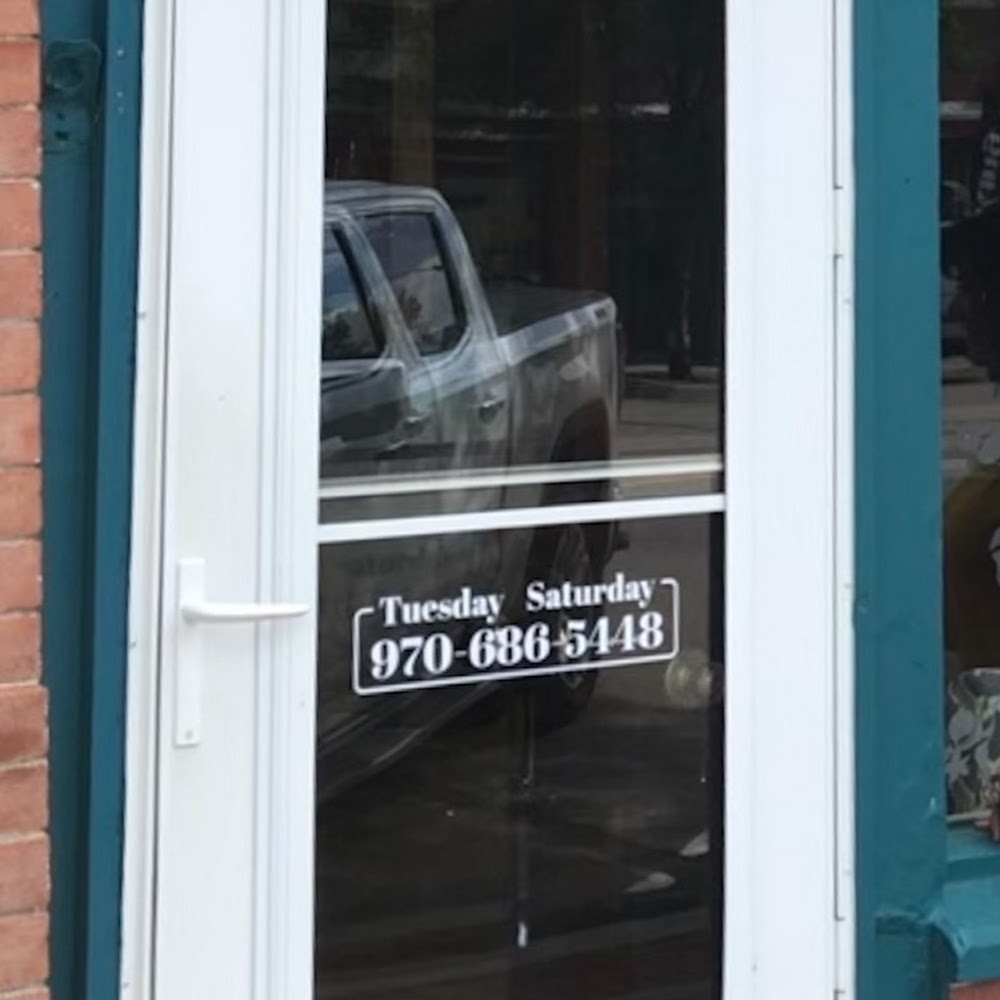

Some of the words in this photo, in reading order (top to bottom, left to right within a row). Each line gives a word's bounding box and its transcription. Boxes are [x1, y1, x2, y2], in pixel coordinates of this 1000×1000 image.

[379, 587, 505, 625] Tuesday
[526, 573, 655, 610] Saturday
[370, 611, 664, 680] 970-686-5448
